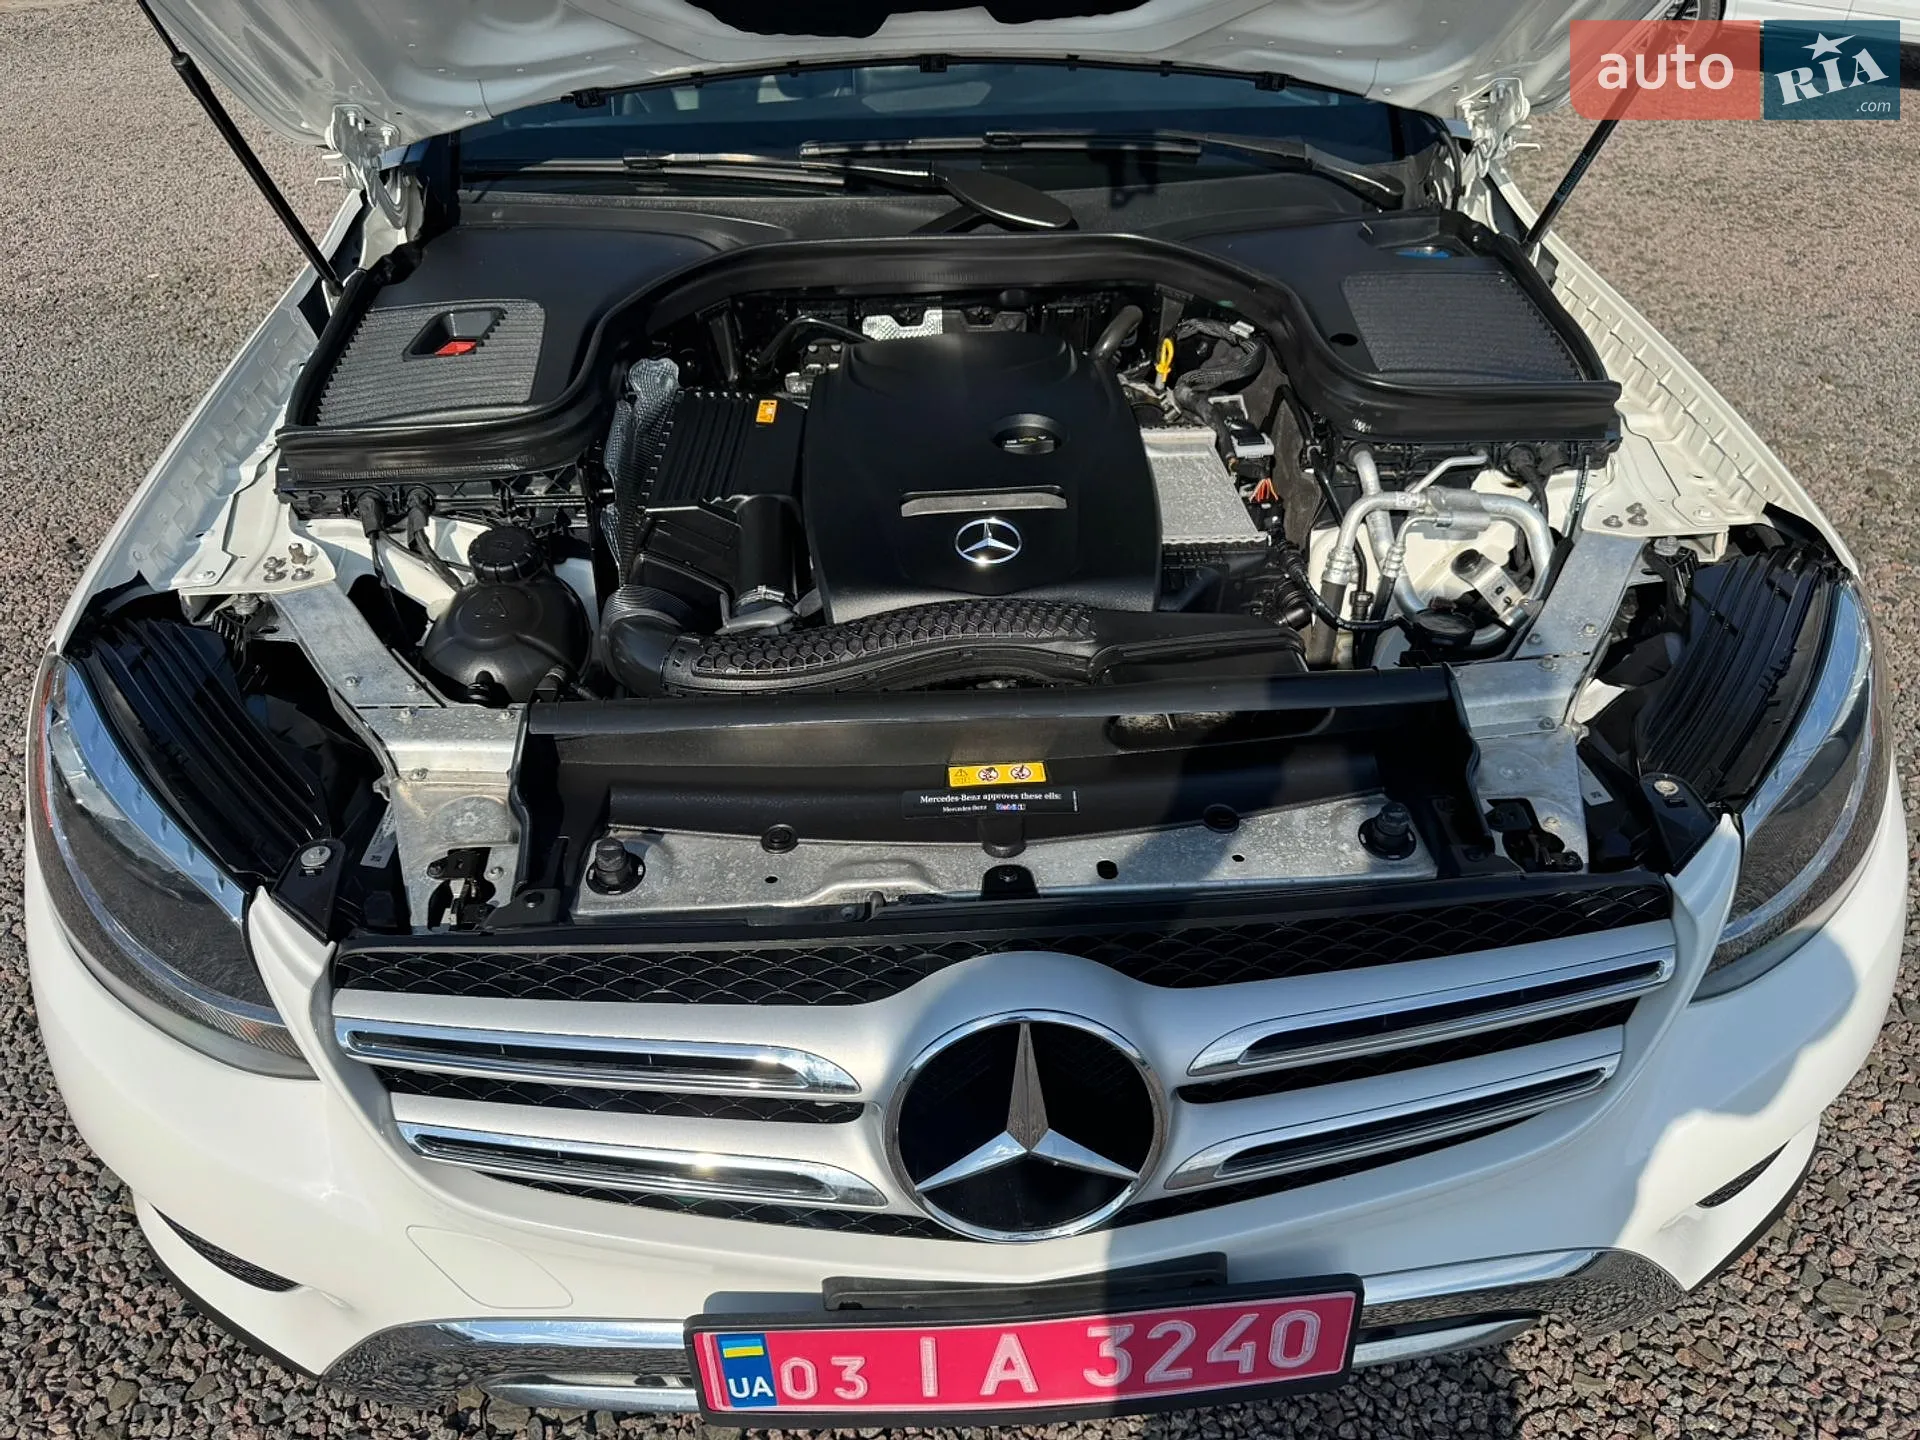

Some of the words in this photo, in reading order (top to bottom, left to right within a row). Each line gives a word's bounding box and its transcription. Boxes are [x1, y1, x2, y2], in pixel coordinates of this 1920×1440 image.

[920, 794, 981, 804] Mercedes-Benz
[982, 792, 1019, 801] approves
[1020, 792, 1043, 800] these
[780, 1357, 868, 1400] 03
[1083, 1309, 1321, 1388] 3240
[728, 1376, 774, 1398] UA
